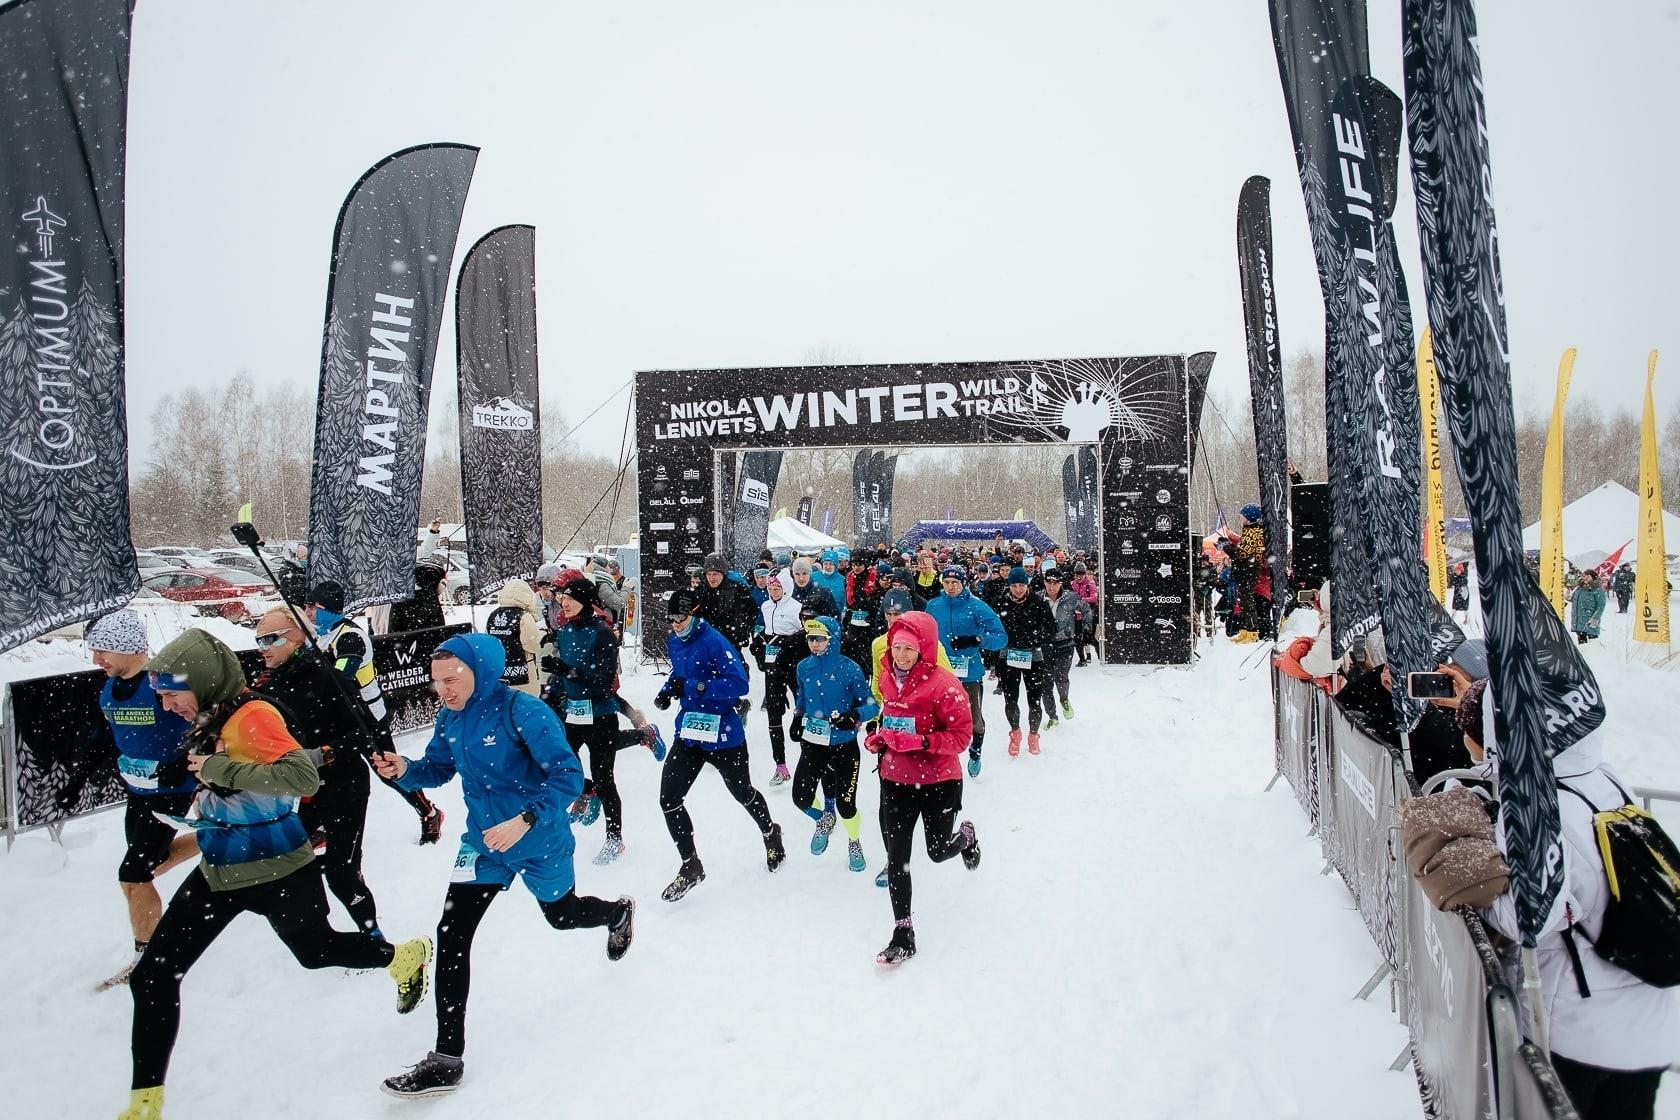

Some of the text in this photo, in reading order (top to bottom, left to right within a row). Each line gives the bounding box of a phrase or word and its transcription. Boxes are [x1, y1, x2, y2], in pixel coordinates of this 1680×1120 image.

[29, 260, 75, 449] OPTIMUM
[356, 292, 417, 497] МАРТИН
[959, 378, 1020, 397] WILD
[670, 398, 752, 420] NIKOLA
[752, 382, 960, 432] WINTER
[960, 395, 1028, 417] TRAIL
[476, 411, 528, 428] TREKKO
[654, 416, 757, 440] LENIVETS
[381, 674, 430, 692] CATHERINE
[387, 667, 424, 681] WELDER
[686, 720, 711, 732] 2232
